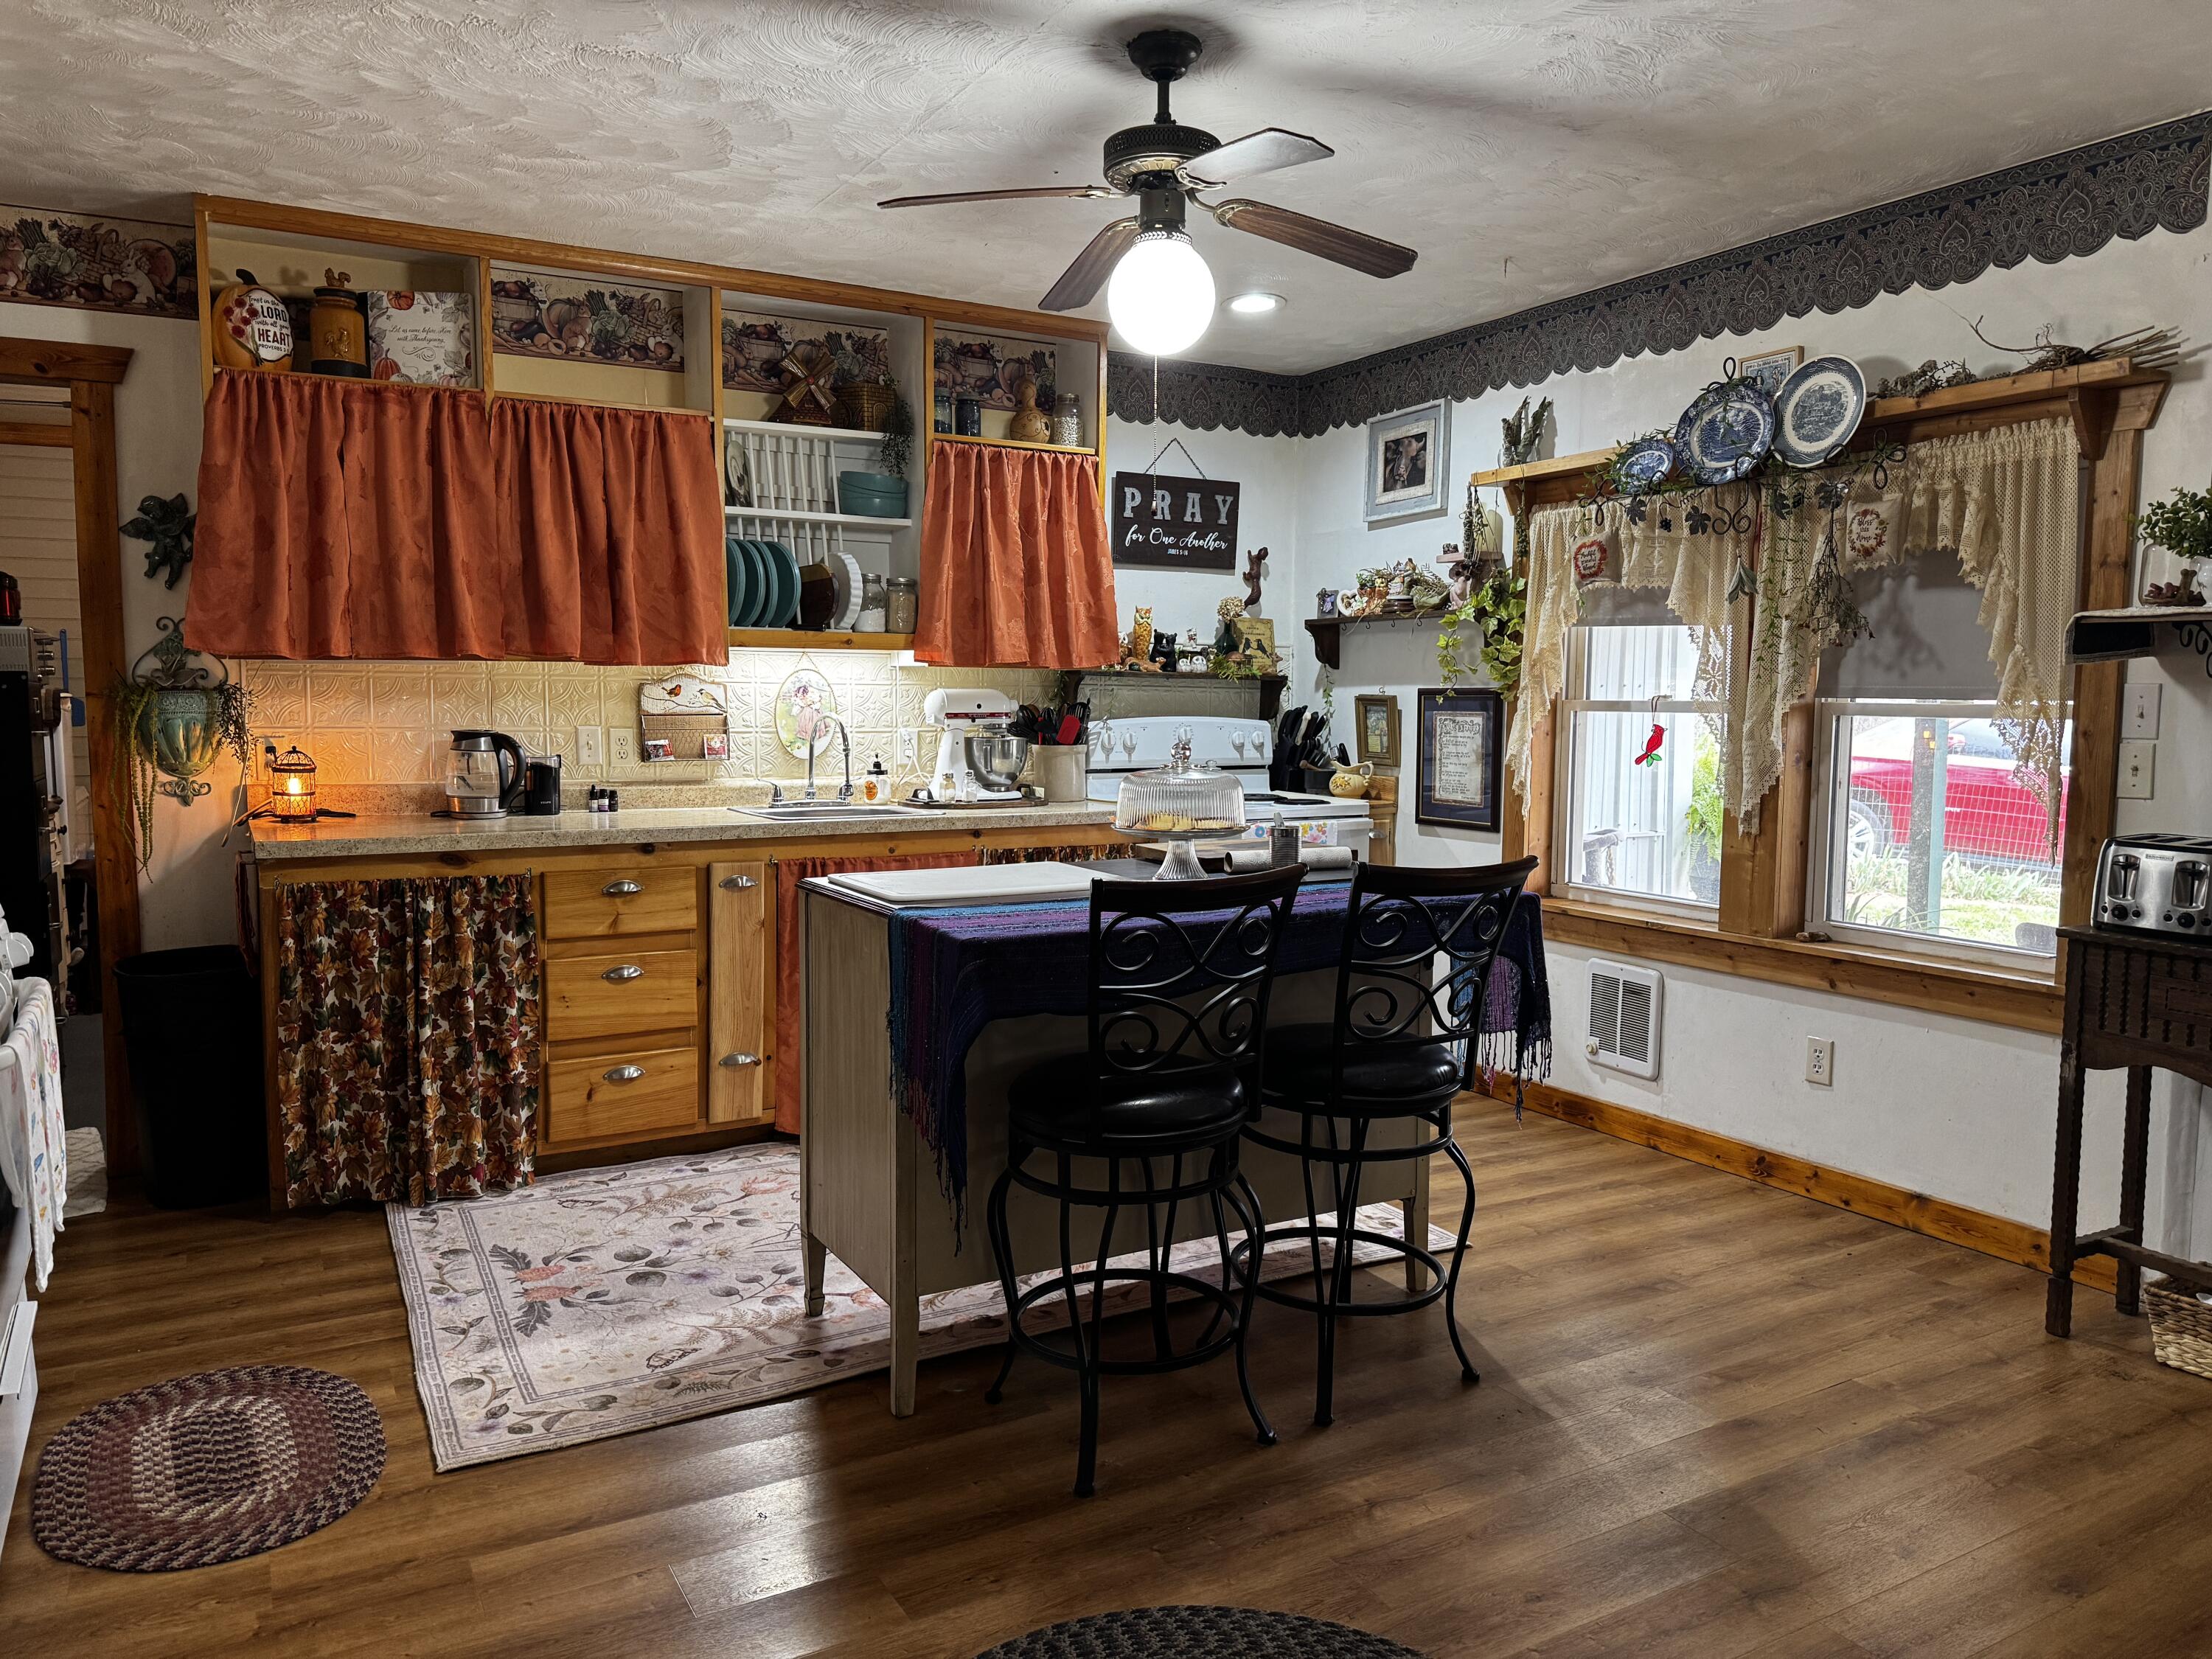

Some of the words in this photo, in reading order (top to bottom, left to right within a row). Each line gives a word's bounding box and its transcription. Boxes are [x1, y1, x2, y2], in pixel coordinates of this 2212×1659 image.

[248, 296, 262, 304] Trust
[261, 305, 287, 322] LORD
[388, 324, 401, 333] Let
[422, 327, 436, 335] before
[258, 328, 290, 347] HEART
[1123, 487, 1234, 525] PRAY
[1857, 516, 1875, 526] Bless
[1125, 524, 1146, 547] for
[1150, 527, 1177, 545] One
[1180, 532, 1228, 552] Another
[1856, 532, 1873, 543] Home
